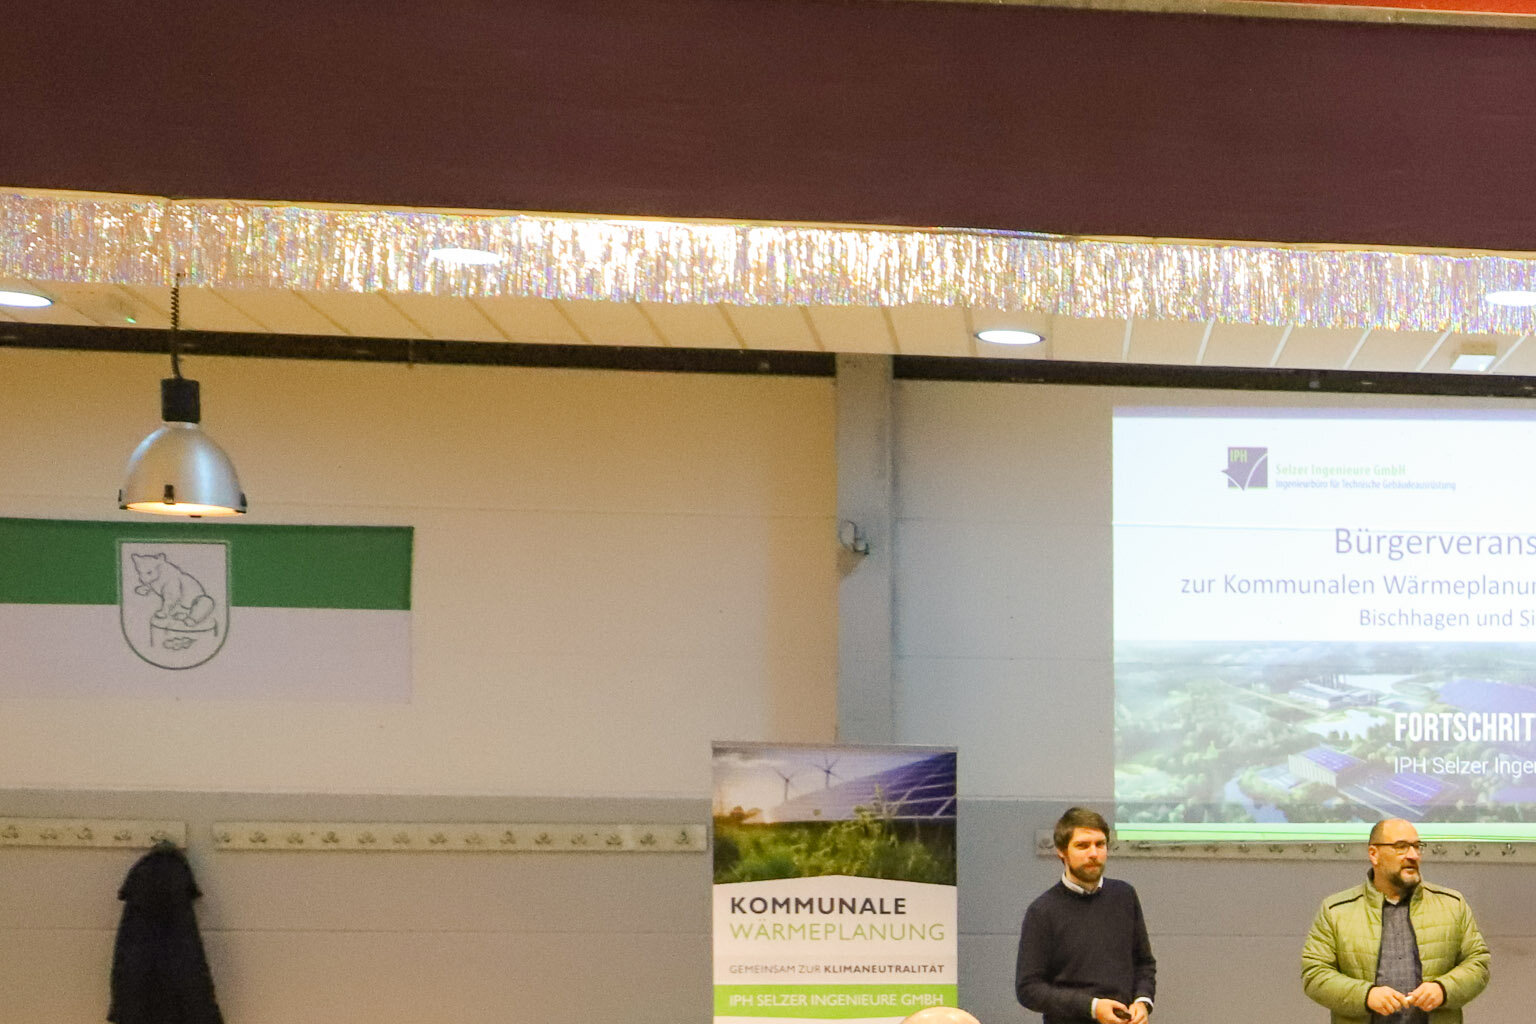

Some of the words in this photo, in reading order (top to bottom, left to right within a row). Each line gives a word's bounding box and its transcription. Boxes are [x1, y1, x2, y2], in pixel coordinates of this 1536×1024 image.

[1230, 449, 1248, 463] IPH
[1311, 464, 1371, 478] Ingenieure
[1373, 464, 1406, 476] GmbH
[1180, 577, 1216, 594] zur
[1224, 574, 1375, 595] Kommunalen
[1359, 608, 1470, 631] Bischhagen
[1477, 609, 1513, 627] und
[1395, 757, 1426, 774] IPH
[1432, 757, 1489, 775] Selzer
[731, 897, 907, 915] KOMMUNALE
[729, 919, 945, 942] WÄRMEPLANUNG
[729, 964, 796, 974] GEMEINSAM
[798, 964, 822, 974] ZUR
[729, 995, 754, 1007] IPH
[757, 995, 808, 1007] SELZER
[811, 994, 897, 1006] INGENIEURE
[901, 994, 944, 1006] GMBH
